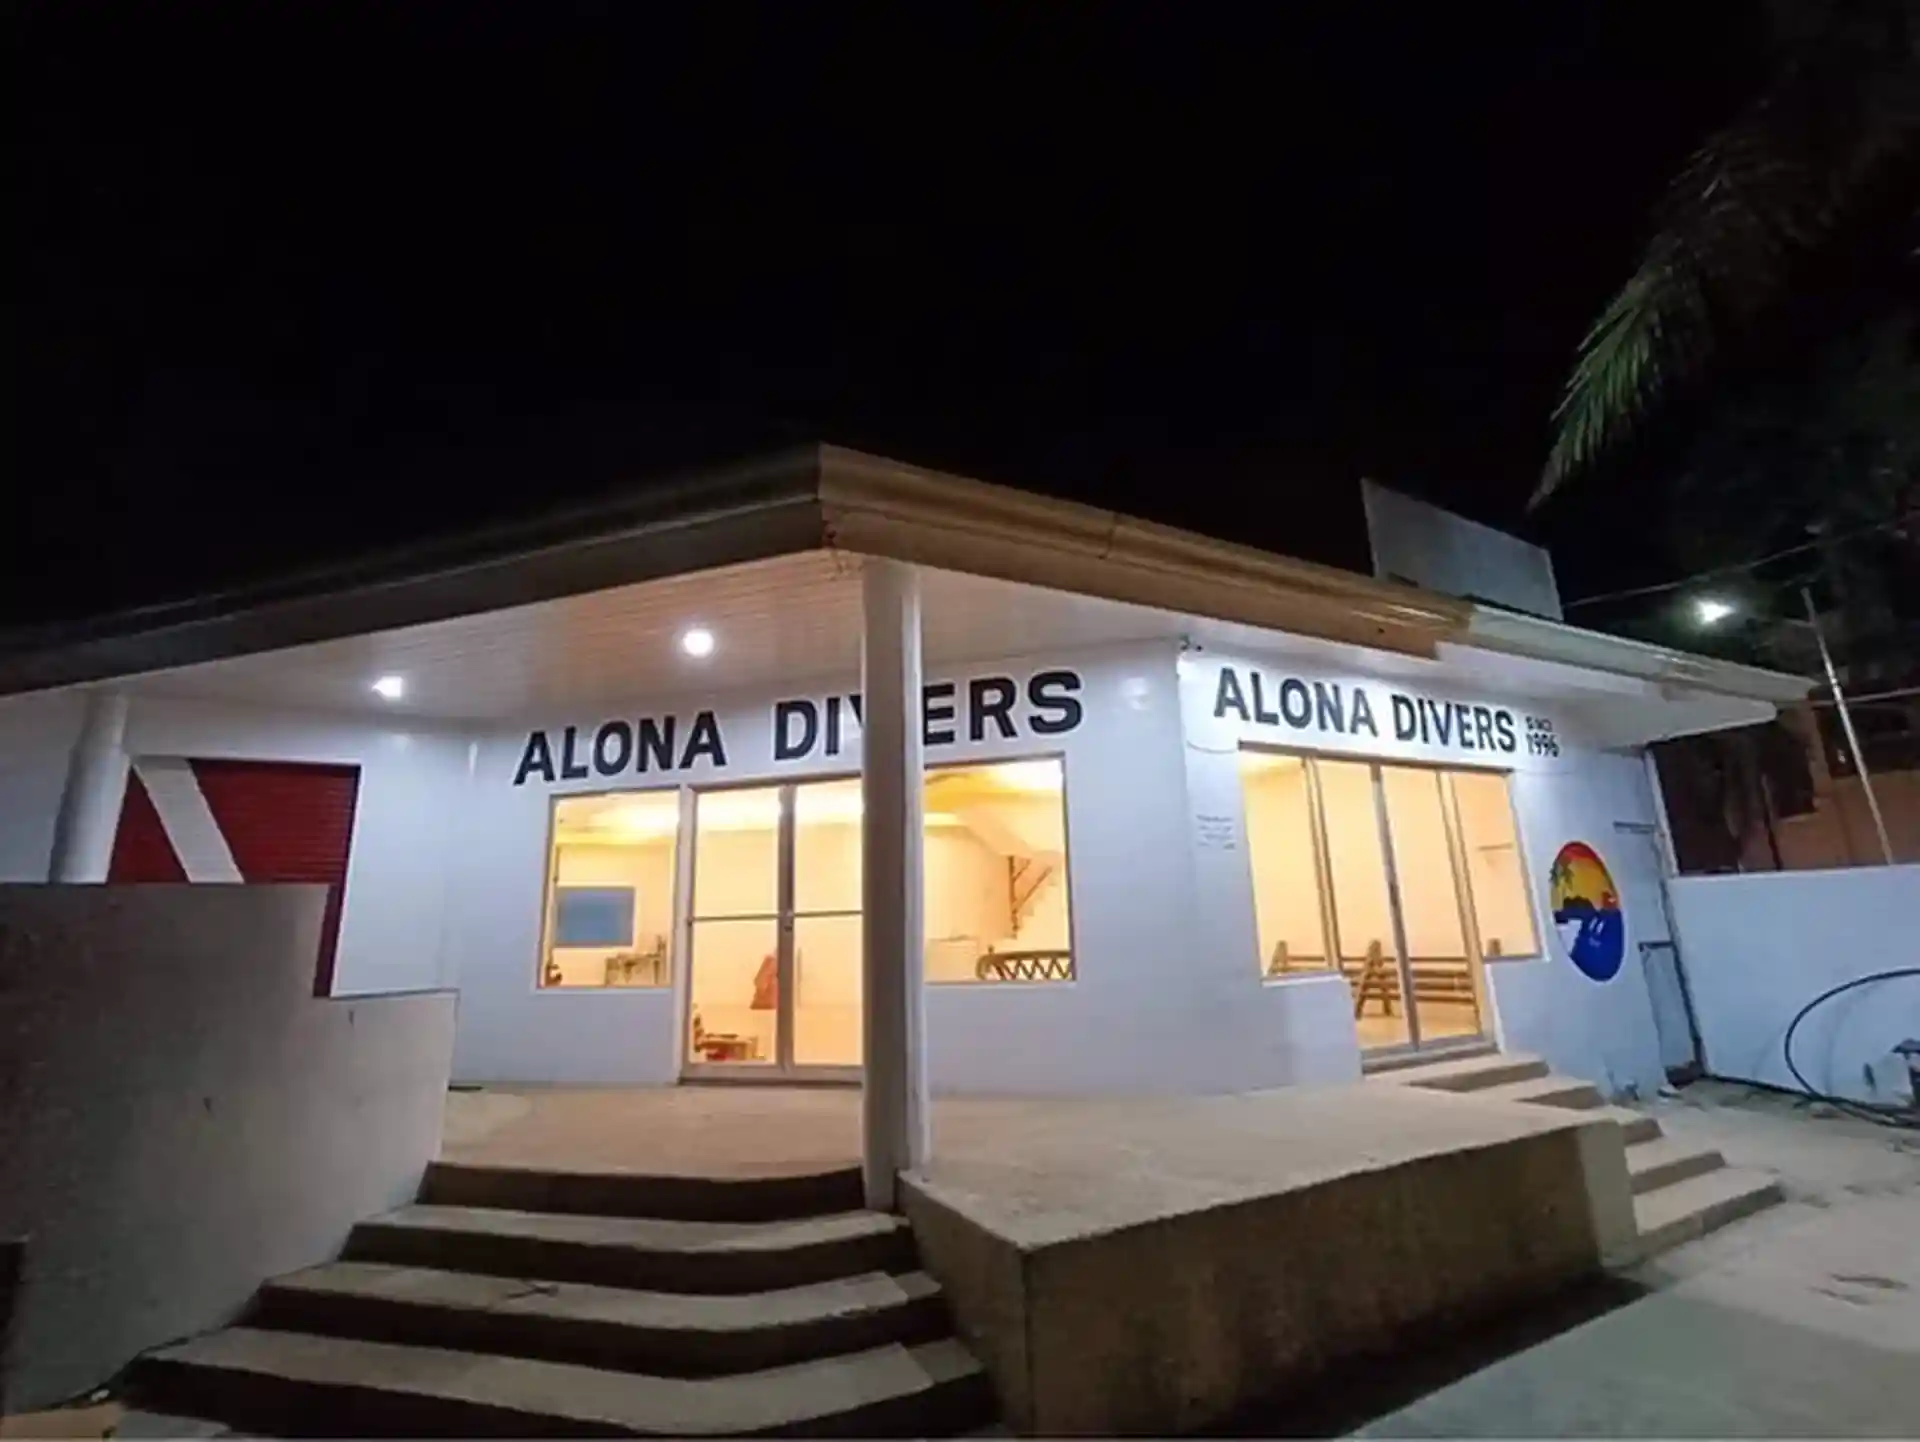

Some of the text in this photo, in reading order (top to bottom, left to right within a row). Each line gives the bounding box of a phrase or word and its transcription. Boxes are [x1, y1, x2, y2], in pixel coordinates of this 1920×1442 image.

[514, 671, 1083, 786] ALONA DIERS
[1213, 667, 1517, 754] ALONA DIVERS
